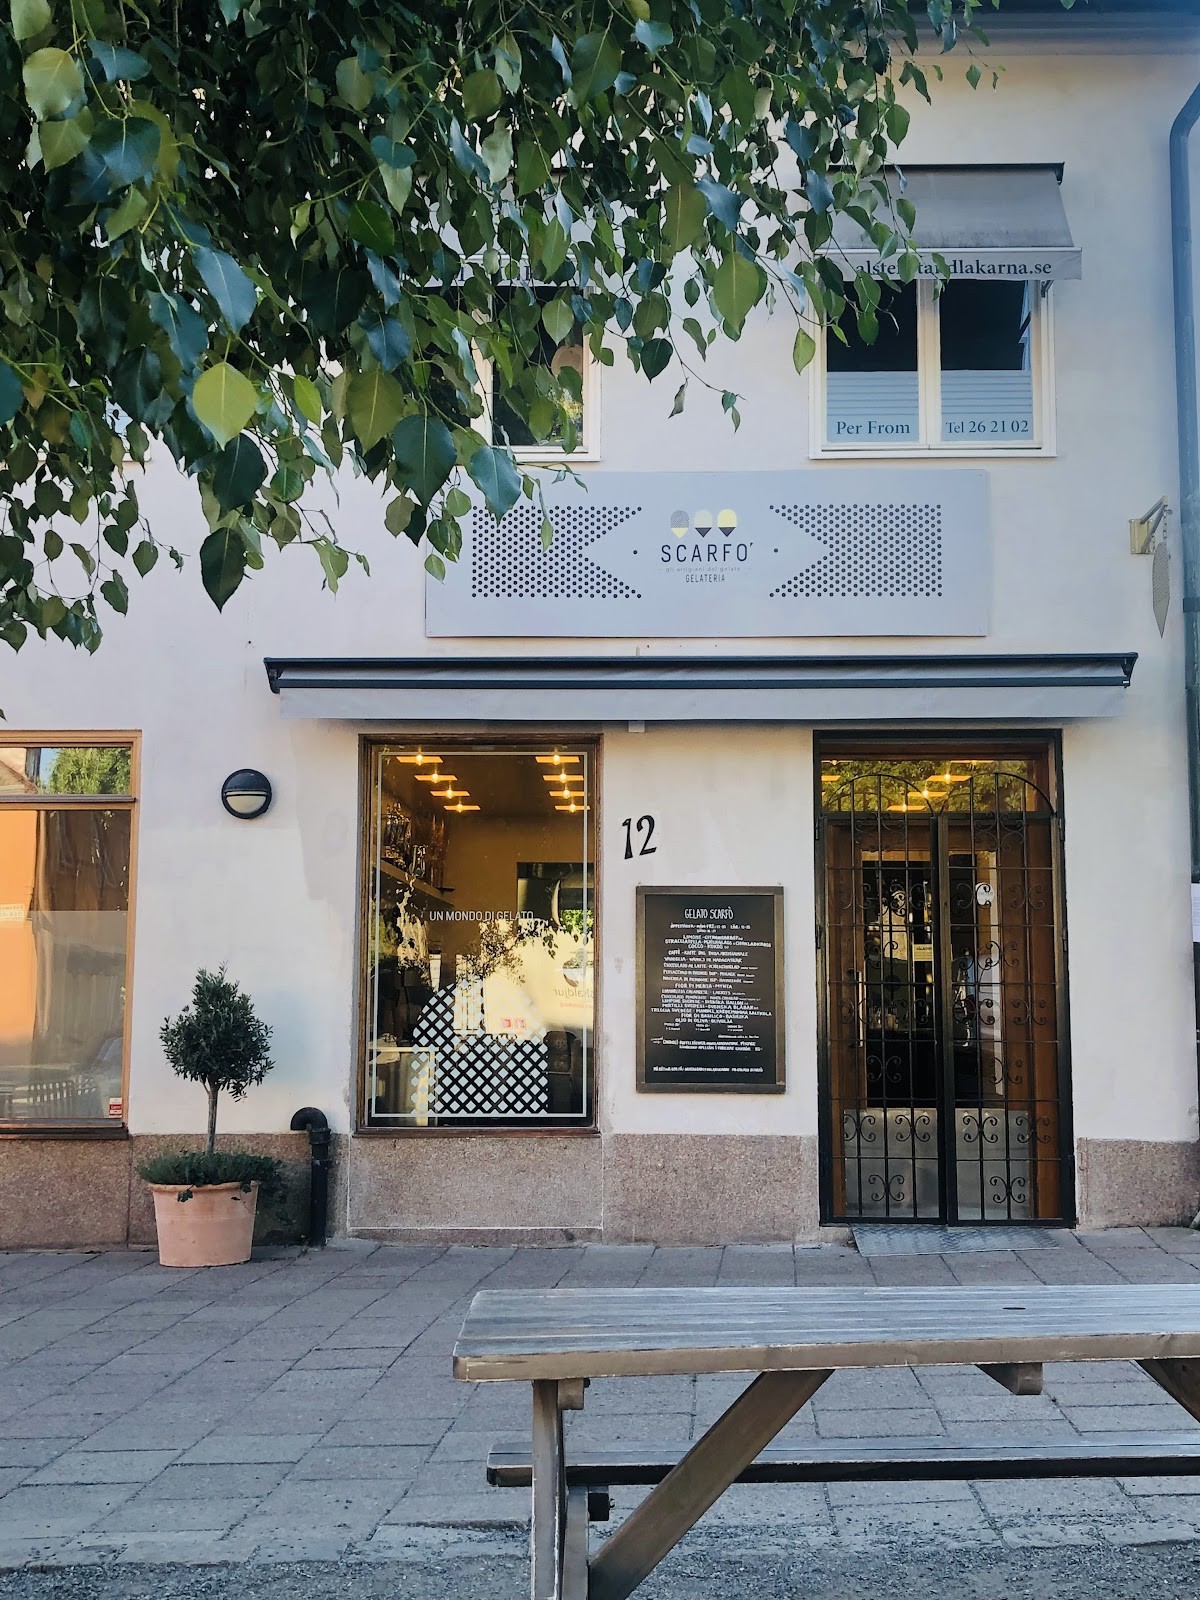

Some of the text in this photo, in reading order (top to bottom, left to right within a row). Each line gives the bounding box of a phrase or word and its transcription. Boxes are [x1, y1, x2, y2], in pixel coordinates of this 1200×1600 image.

[836, 421, 911, 434] Per From
[945, 419, 1029, 434] Tel 26 21 02
[685, 574, 726, 583] GELATERIA
[621, 814, 657, 860] 12
[429, 911, 534, 921] UN MONDO DI GELATO
[684, 908, 708, 920] GELATO
